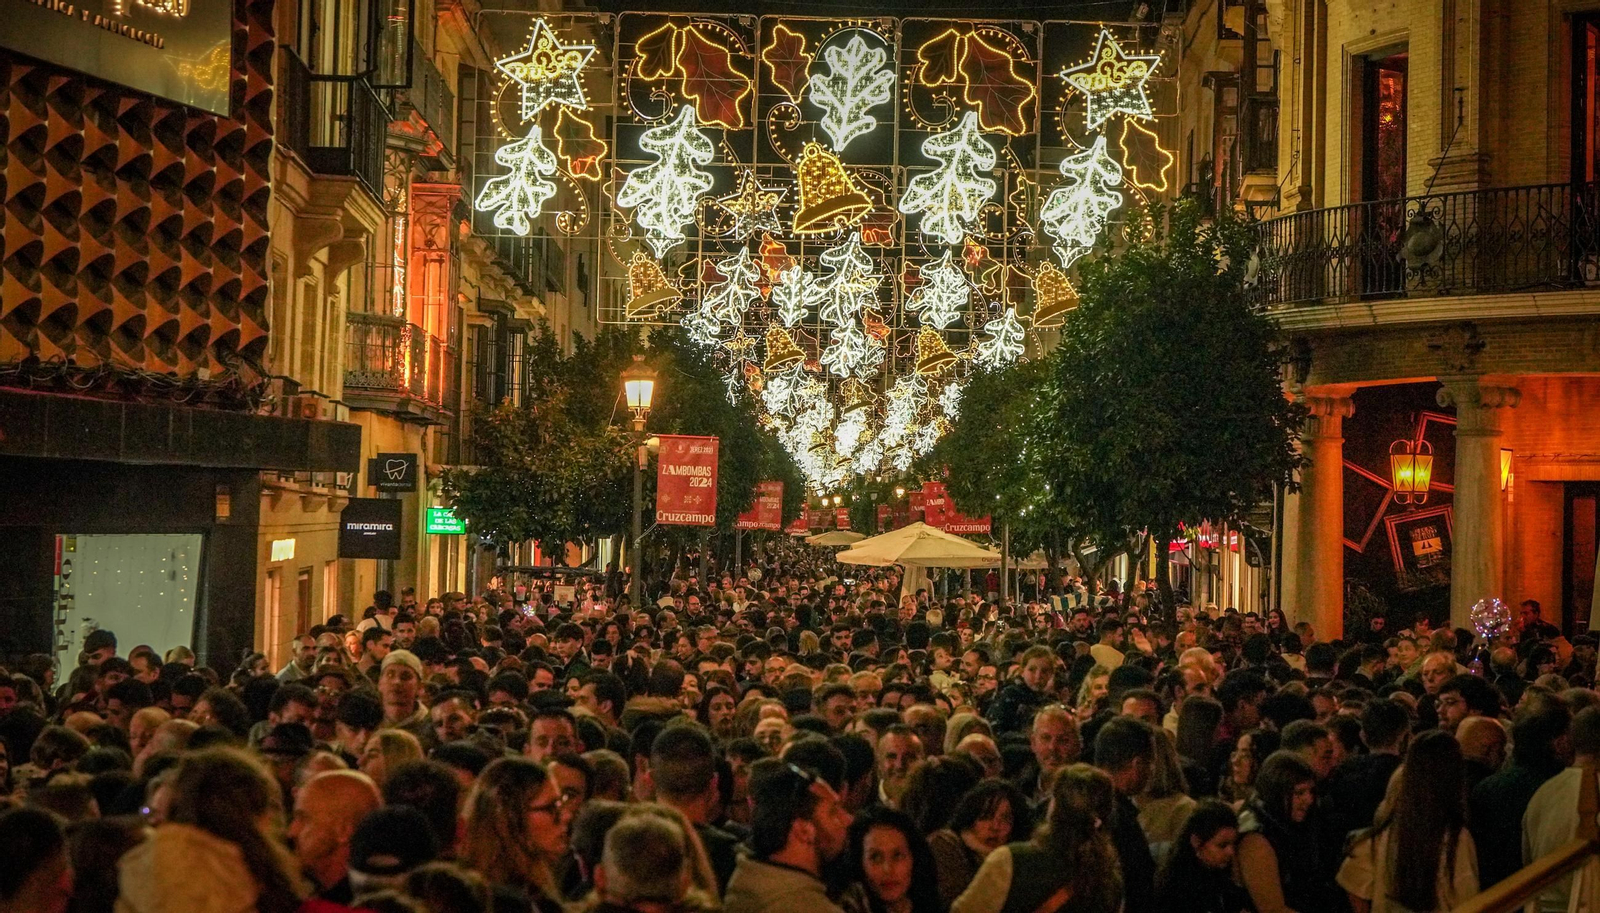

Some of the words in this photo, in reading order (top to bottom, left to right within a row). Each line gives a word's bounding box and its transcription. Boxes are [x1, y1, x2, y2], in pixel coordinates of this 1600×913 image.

[662, 464, 712, 477] ZAMBOMBAS
[689, 477, 712, 488] 2024
[656, 510, 715, 524] Cruzcampo
[347, 522, 393, 531] miramira
[945, 523, 990, 533] Cruzcampo
